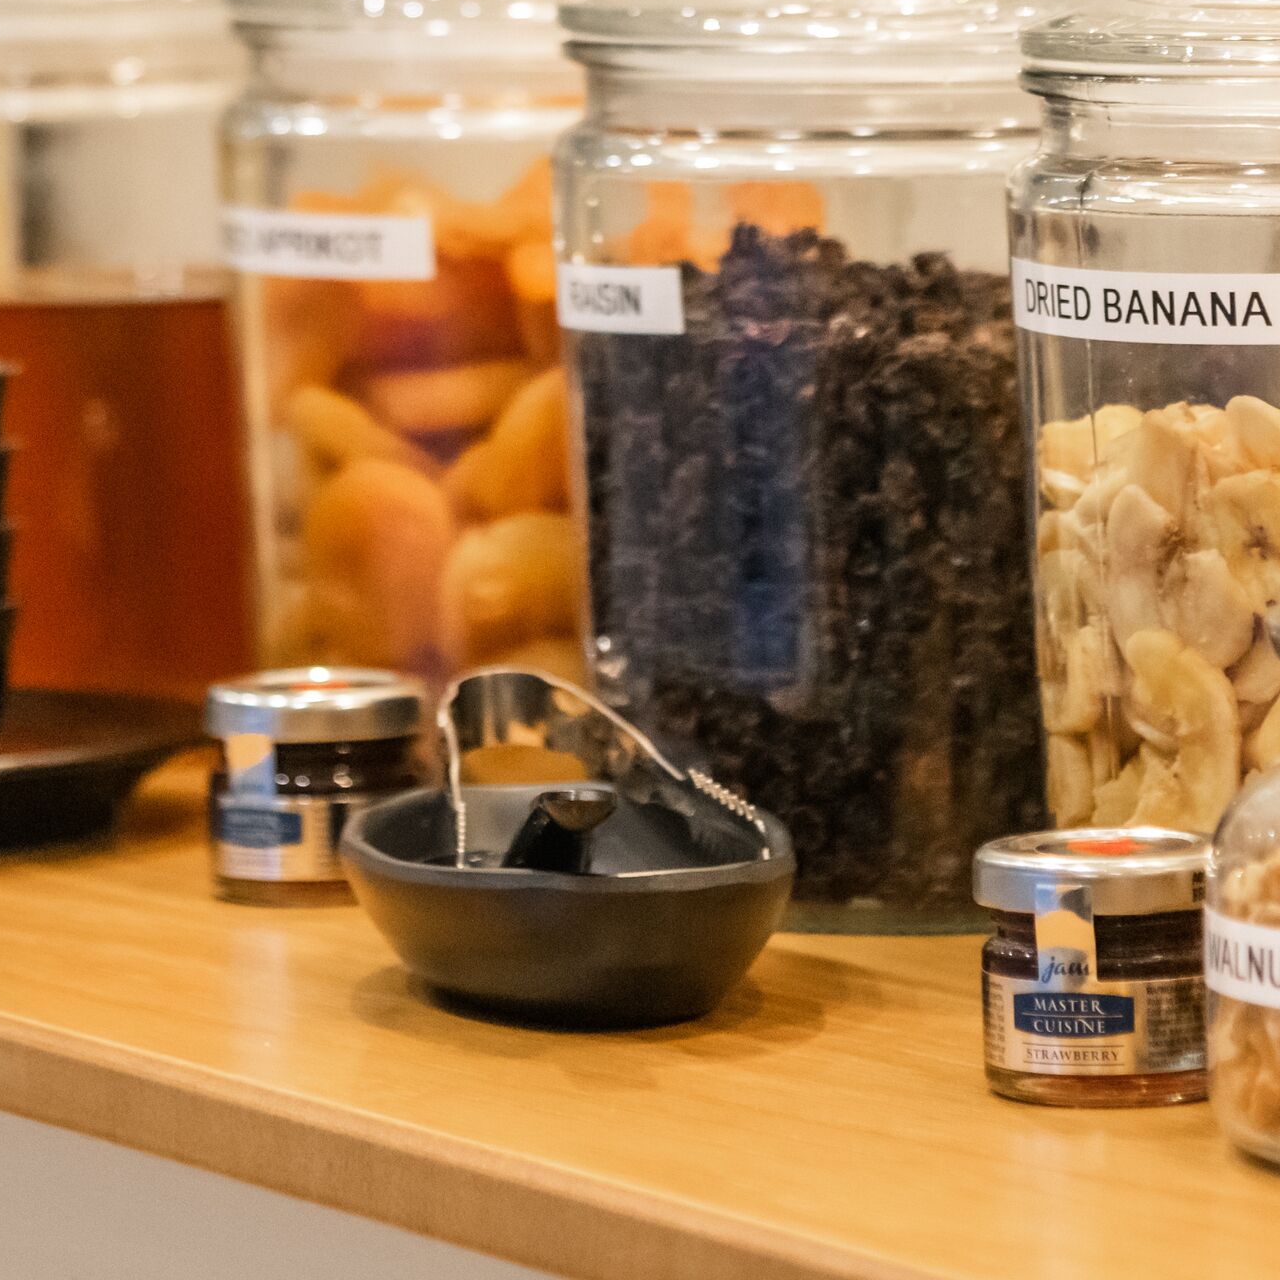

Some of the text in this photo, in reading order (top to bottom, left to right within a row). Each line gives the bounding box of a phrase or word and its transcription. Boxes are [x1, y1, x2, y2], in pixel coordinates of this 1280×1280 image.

[1025, 278, 1273, 327] DRIED BANANA
[1033, 997, 1105, 1015] MASTER
[1033, 1019, 1106, 1034] CUISINE
[1026, 1048, 1119, 1062] STRAWBERRY
